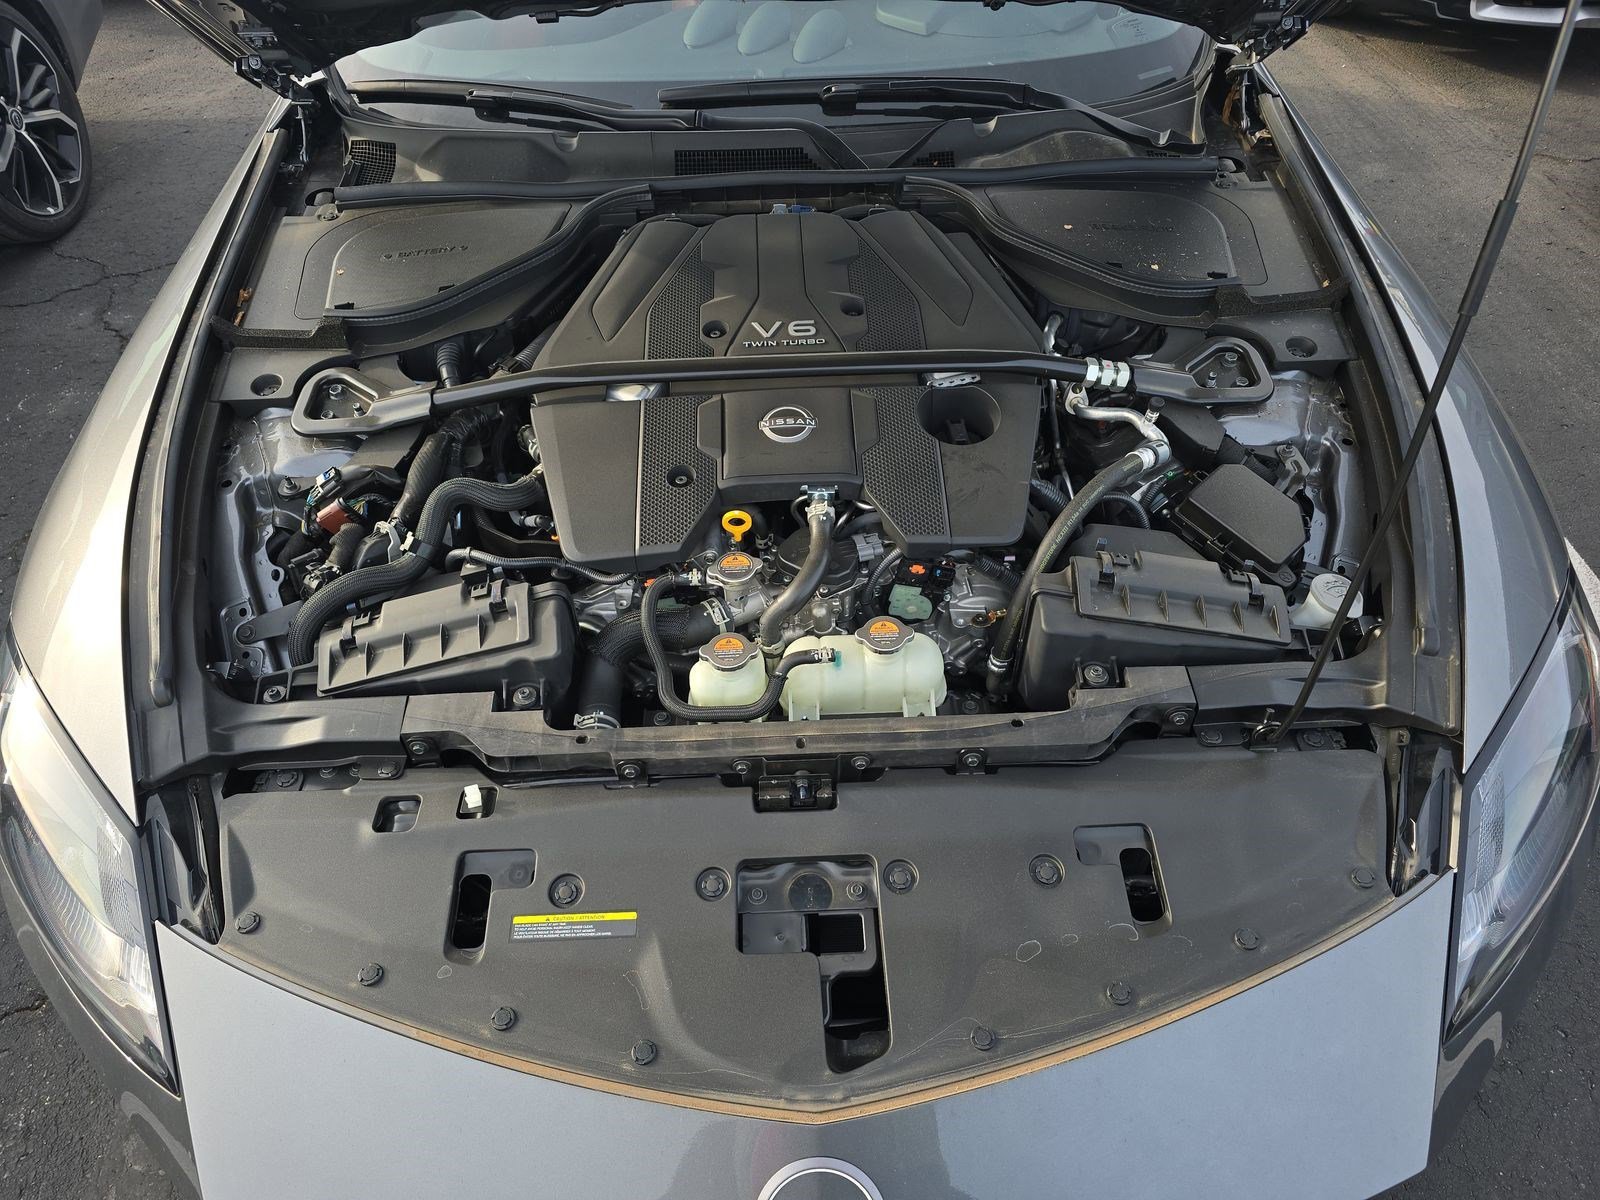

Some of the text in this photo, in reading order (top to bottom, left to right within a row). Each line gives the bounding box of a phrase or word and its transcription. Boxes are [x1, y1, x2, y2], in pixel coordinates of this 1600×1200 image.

[398, 245, 456, 258] BATTERY
[751, 319, 817, 338] V6
[742, 338, 826, 348] TWIN TURBO
[760, 418, 815, 427] NISSAN
